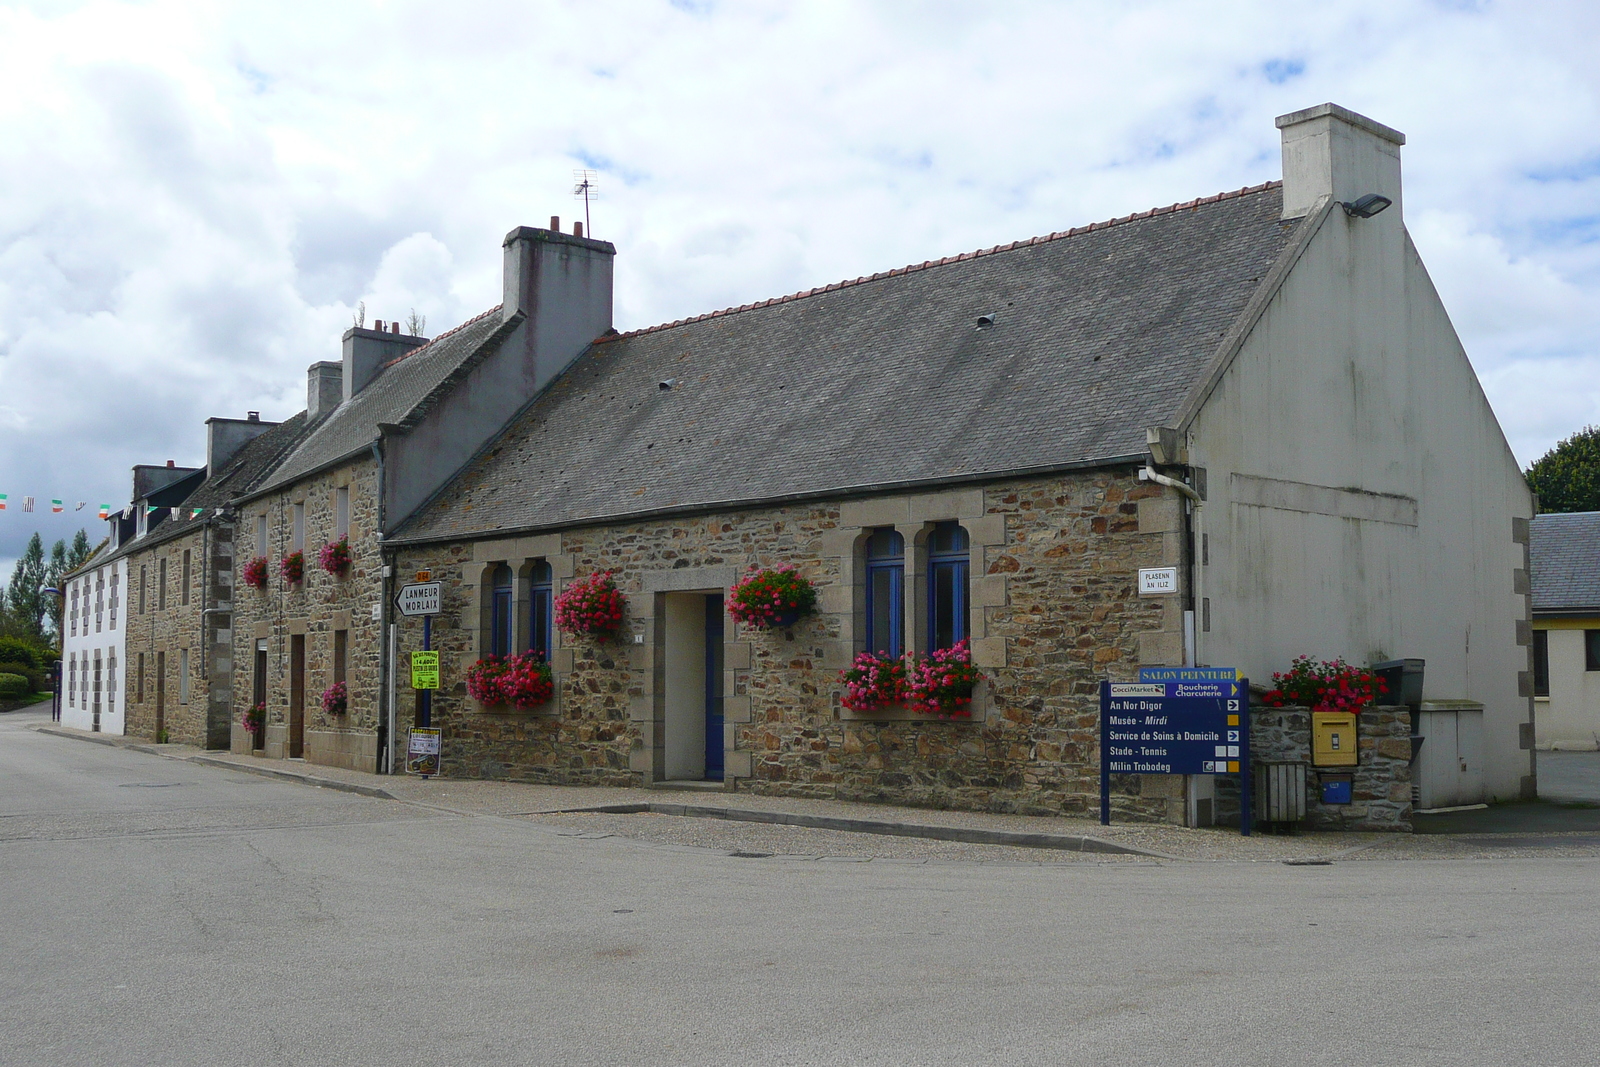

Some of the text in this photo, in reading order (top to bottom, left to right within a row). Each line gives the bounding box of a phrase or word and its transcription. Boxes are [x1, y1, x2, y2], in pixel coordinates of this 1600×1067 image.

[406, 588, 438, 599] LANMEUR
[406, 600, 438, 610] MORLAIX
[1142, 672, 1234, 680] SALON PEINTURE
[1110, 701, 1162, 711] An Nor Digor
[1110, 716, 1136, 725] Musée
[1145, 716, 1168, 725] Mirdi
[1110, 731, 1219, 740] Service de Soins à Domicile
[1110, 746, 1132, 755] Stade
[1141, 747, 1167, 756] Tennis
[1110, 762, 1171, 772] Milin Trobodeg
